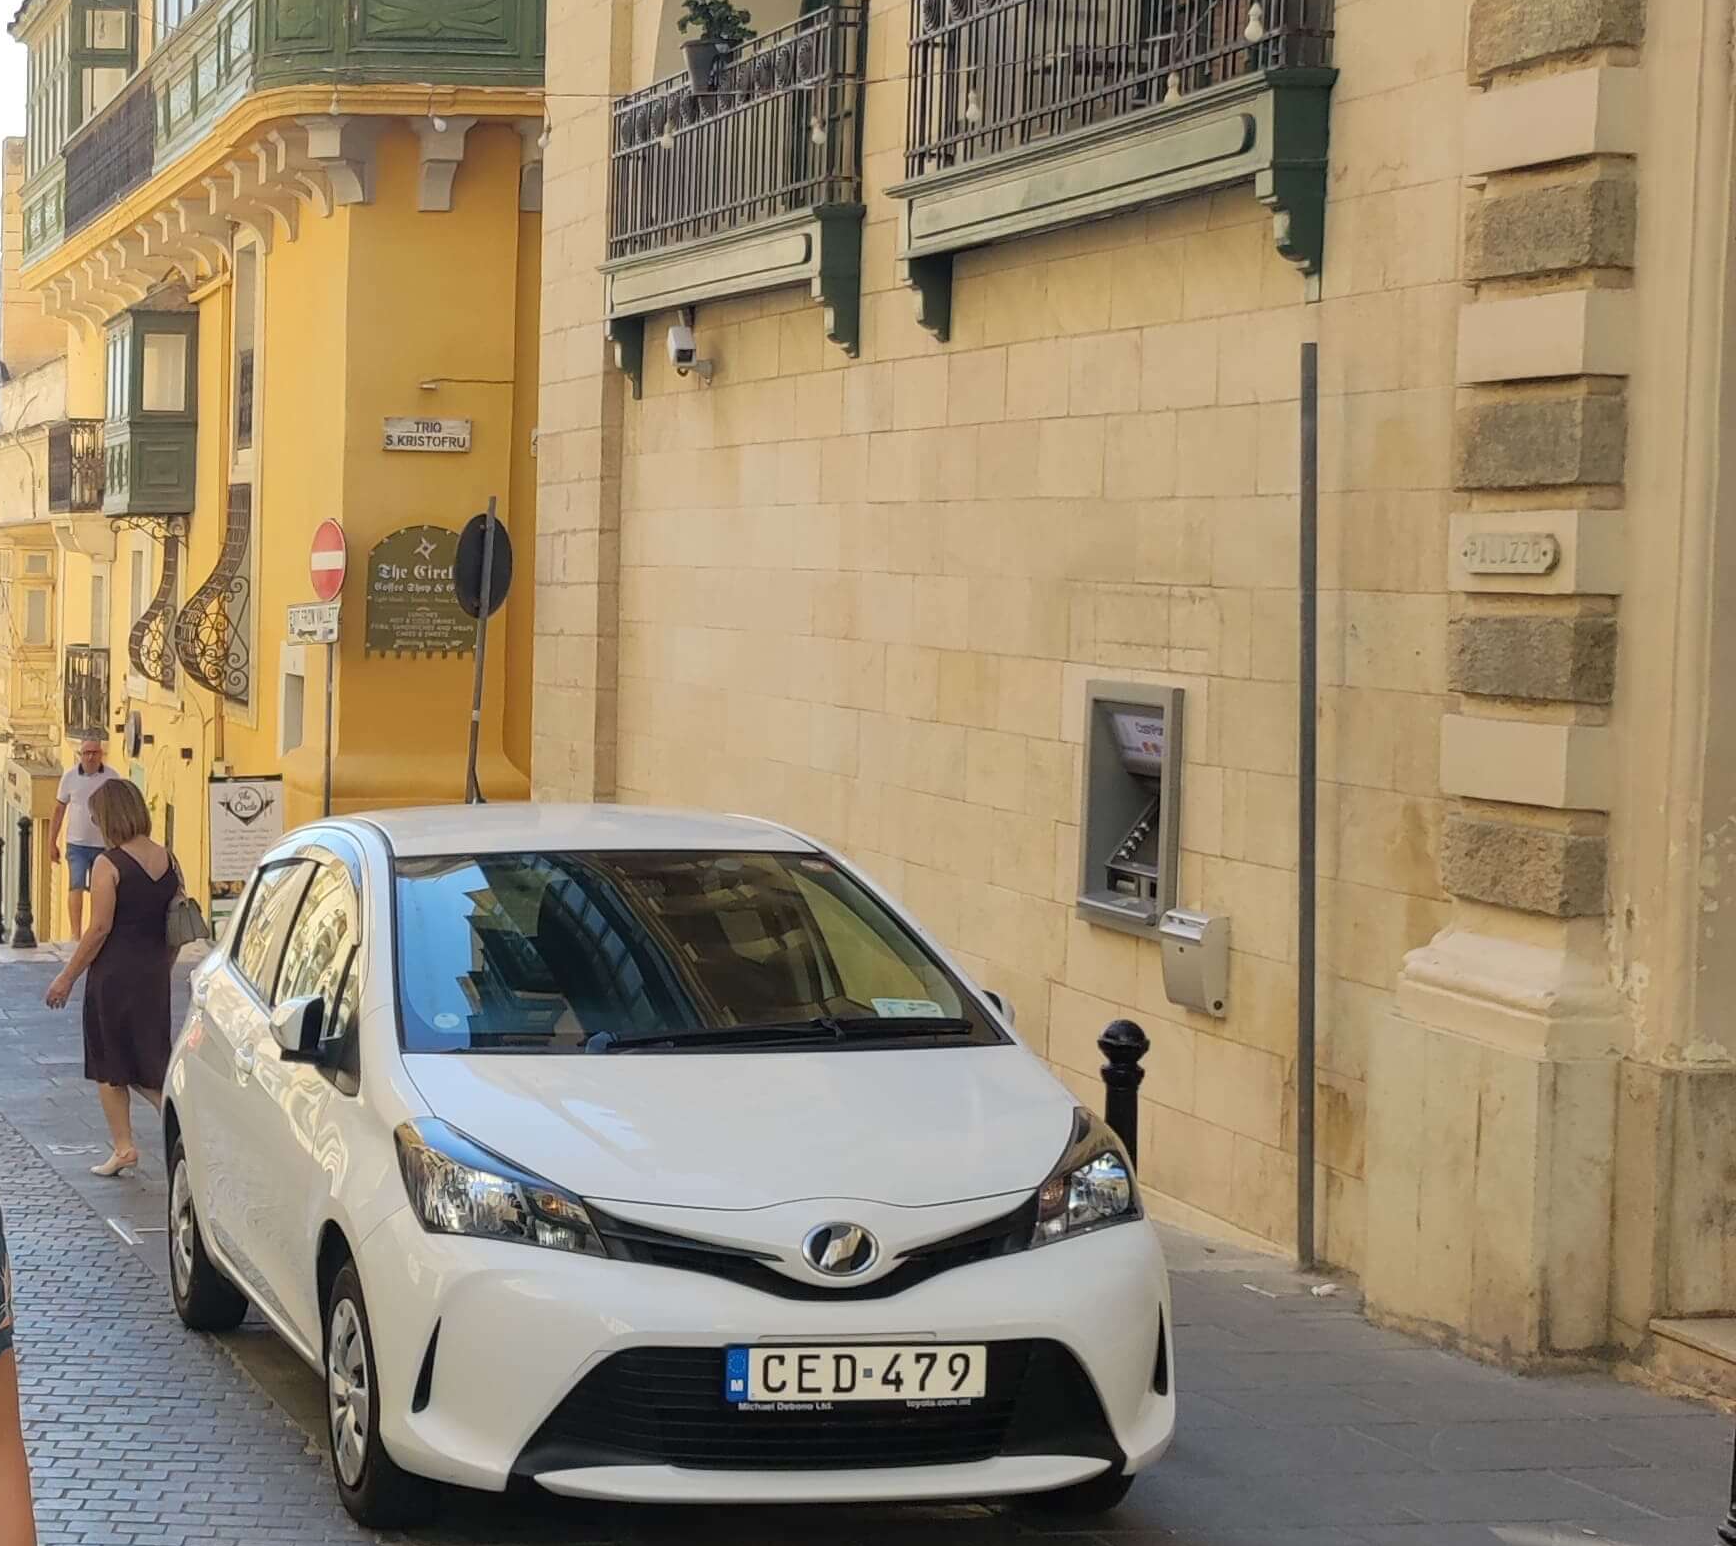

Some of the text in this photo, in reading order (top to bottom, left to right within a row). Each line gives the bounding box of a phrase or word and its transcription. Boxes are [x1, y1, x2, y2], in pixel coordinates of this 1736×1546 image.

[414, 421, 442, 433] TRIQ
[397, 435, 466, 448] KRISTOFRU
[1469, 540, 1541, 564] PALAZZO
[377, 564, 454, 581] The Circl
[374, 582, 404, 593] Coffee
[730, 1379, 744, 1392] M
[738, 1402, 776, 1411] Michael
[777, 1402, 814, 1411] Debono
